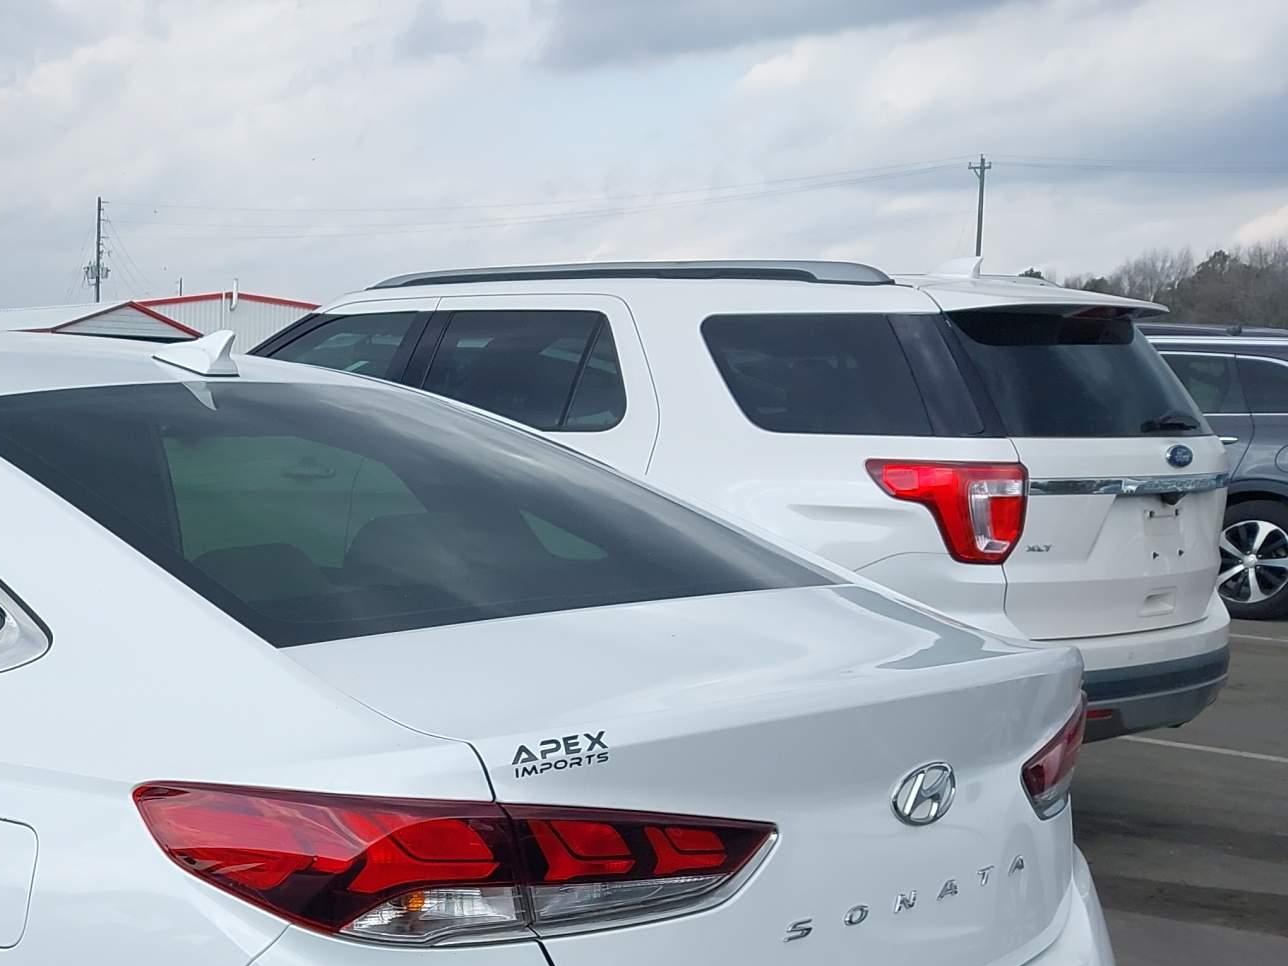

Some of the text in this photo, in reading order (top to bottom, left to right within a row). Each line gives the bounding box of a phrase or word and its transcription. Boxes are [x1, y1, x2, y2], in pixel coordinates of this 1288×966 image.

[511, 731, 608, 765] APEX
[515, 752, 609, 778] IMPORTS
[783, 855, 1025, 943] SONATA
